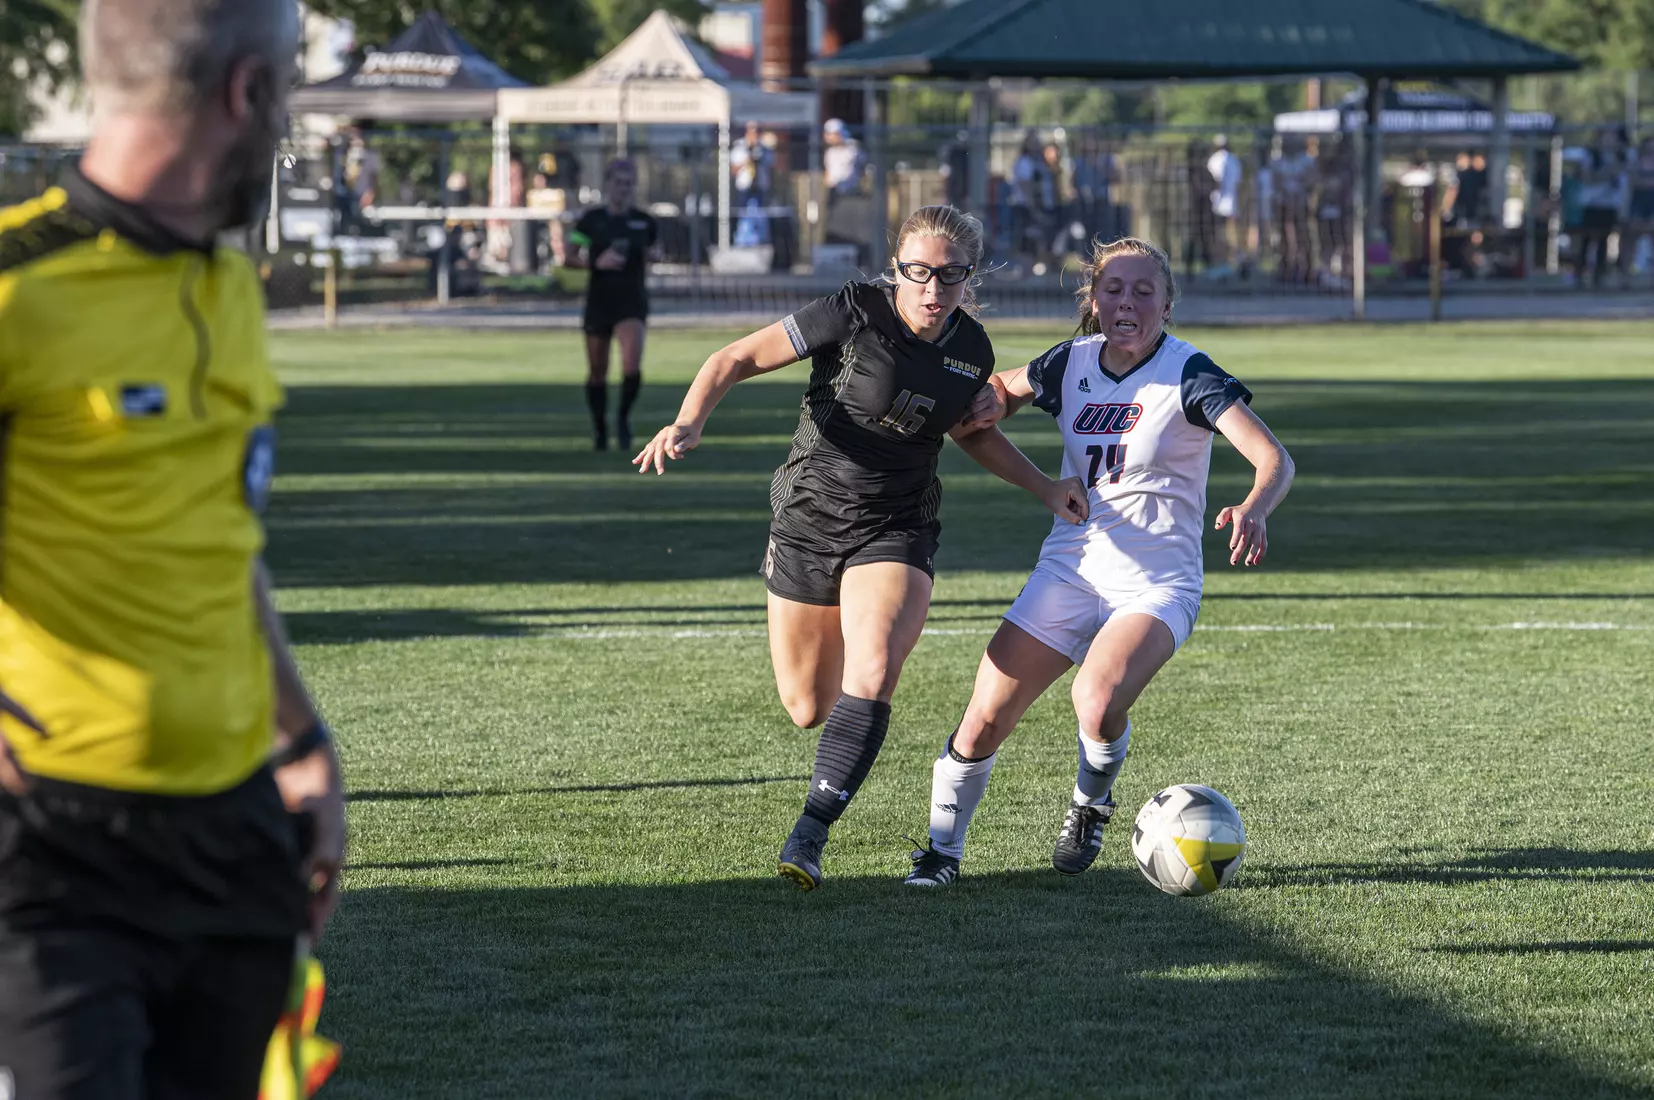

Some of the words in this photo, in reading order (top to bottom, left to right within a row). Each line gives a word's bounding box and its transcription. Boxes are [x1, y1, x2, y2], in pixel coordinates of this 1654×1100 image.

[943, 356, 982, 377] PURDUE
[880, 388, 936, 437] 16
[1072, 402, 1144, 435] UIC
[1085, 443, 1128, 489] 24
